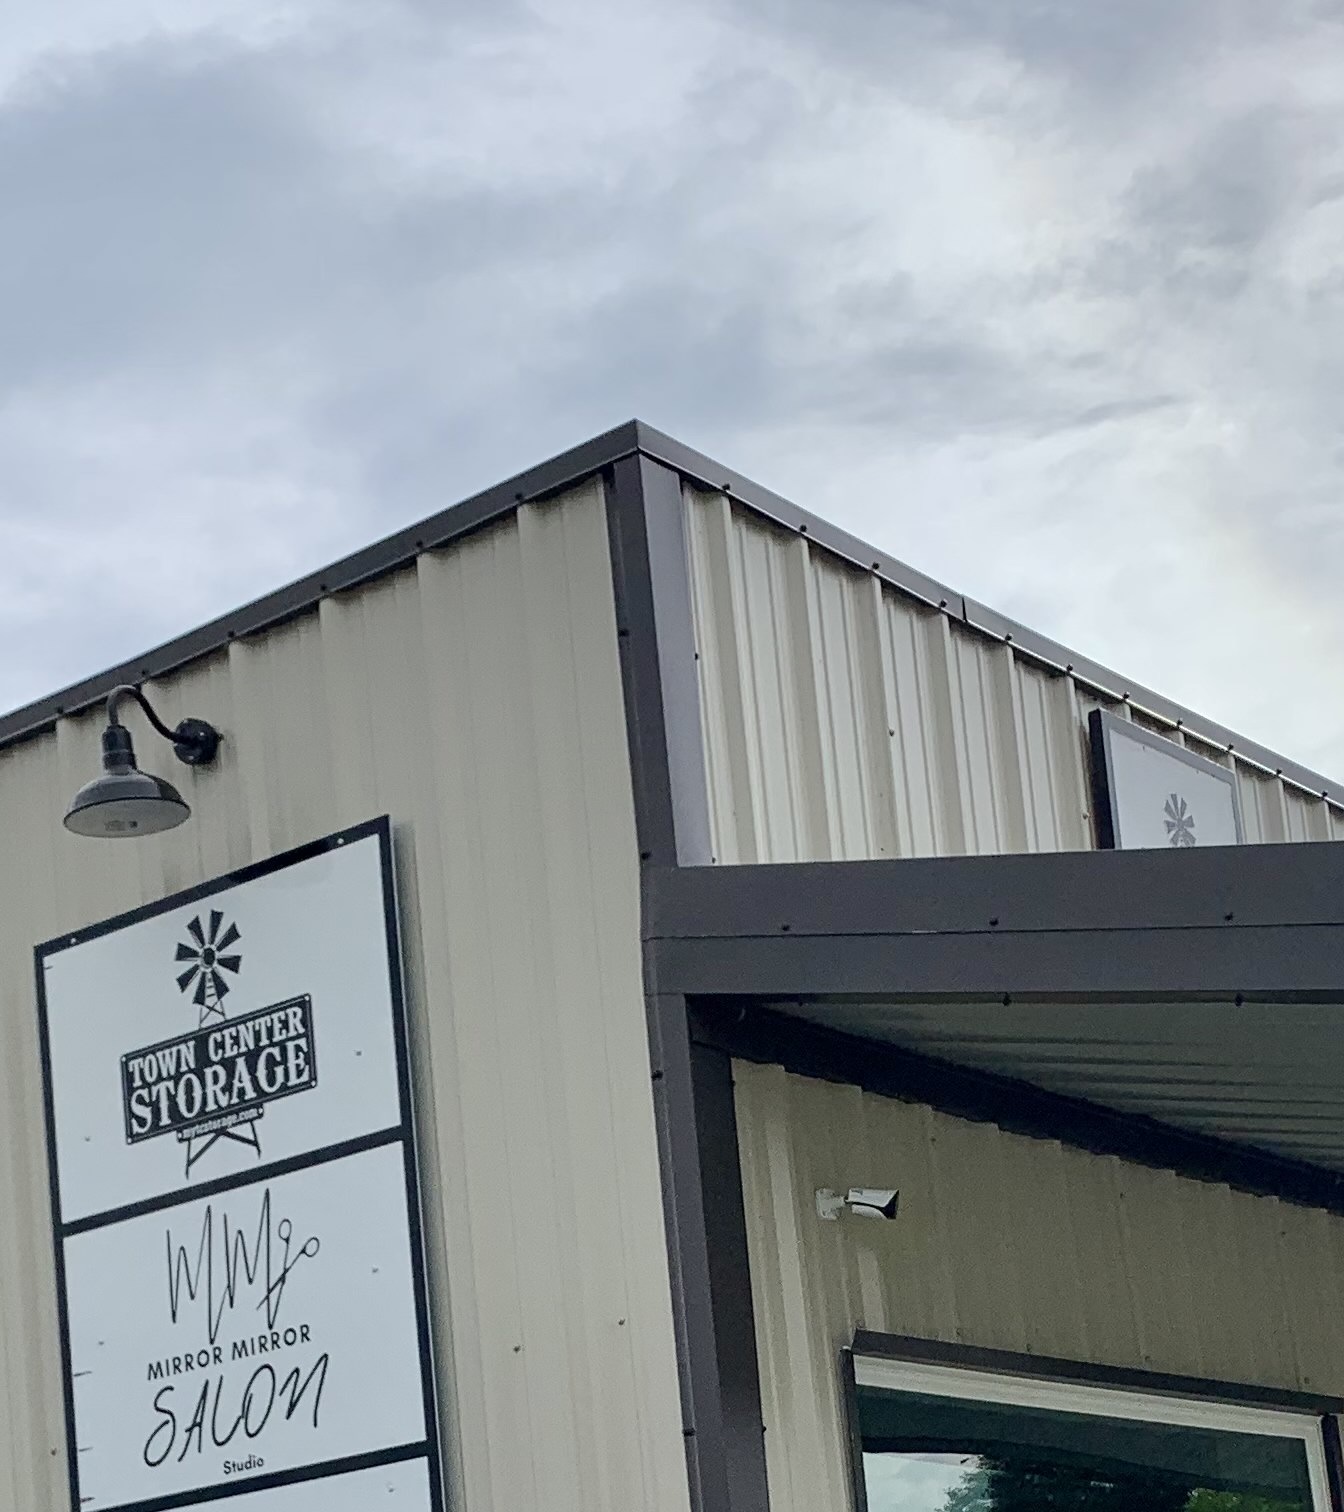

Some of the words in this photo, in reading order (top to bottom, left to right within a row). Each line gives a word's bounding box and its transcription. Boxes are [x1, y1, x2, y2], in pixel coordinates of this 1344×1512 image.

[128, 1040, 196, 1088] TOWN
[207, 1006, 306, 1063] CENTER
[129, 1038, 310, 1135] STORAGE
[146, 1346, 223, 1381] MIRROR
[231, 1324, 311, 1361] MIRROR
[143, 1352, 329, 1467] SALON
[222, 1454, 264, 1475] Studio
